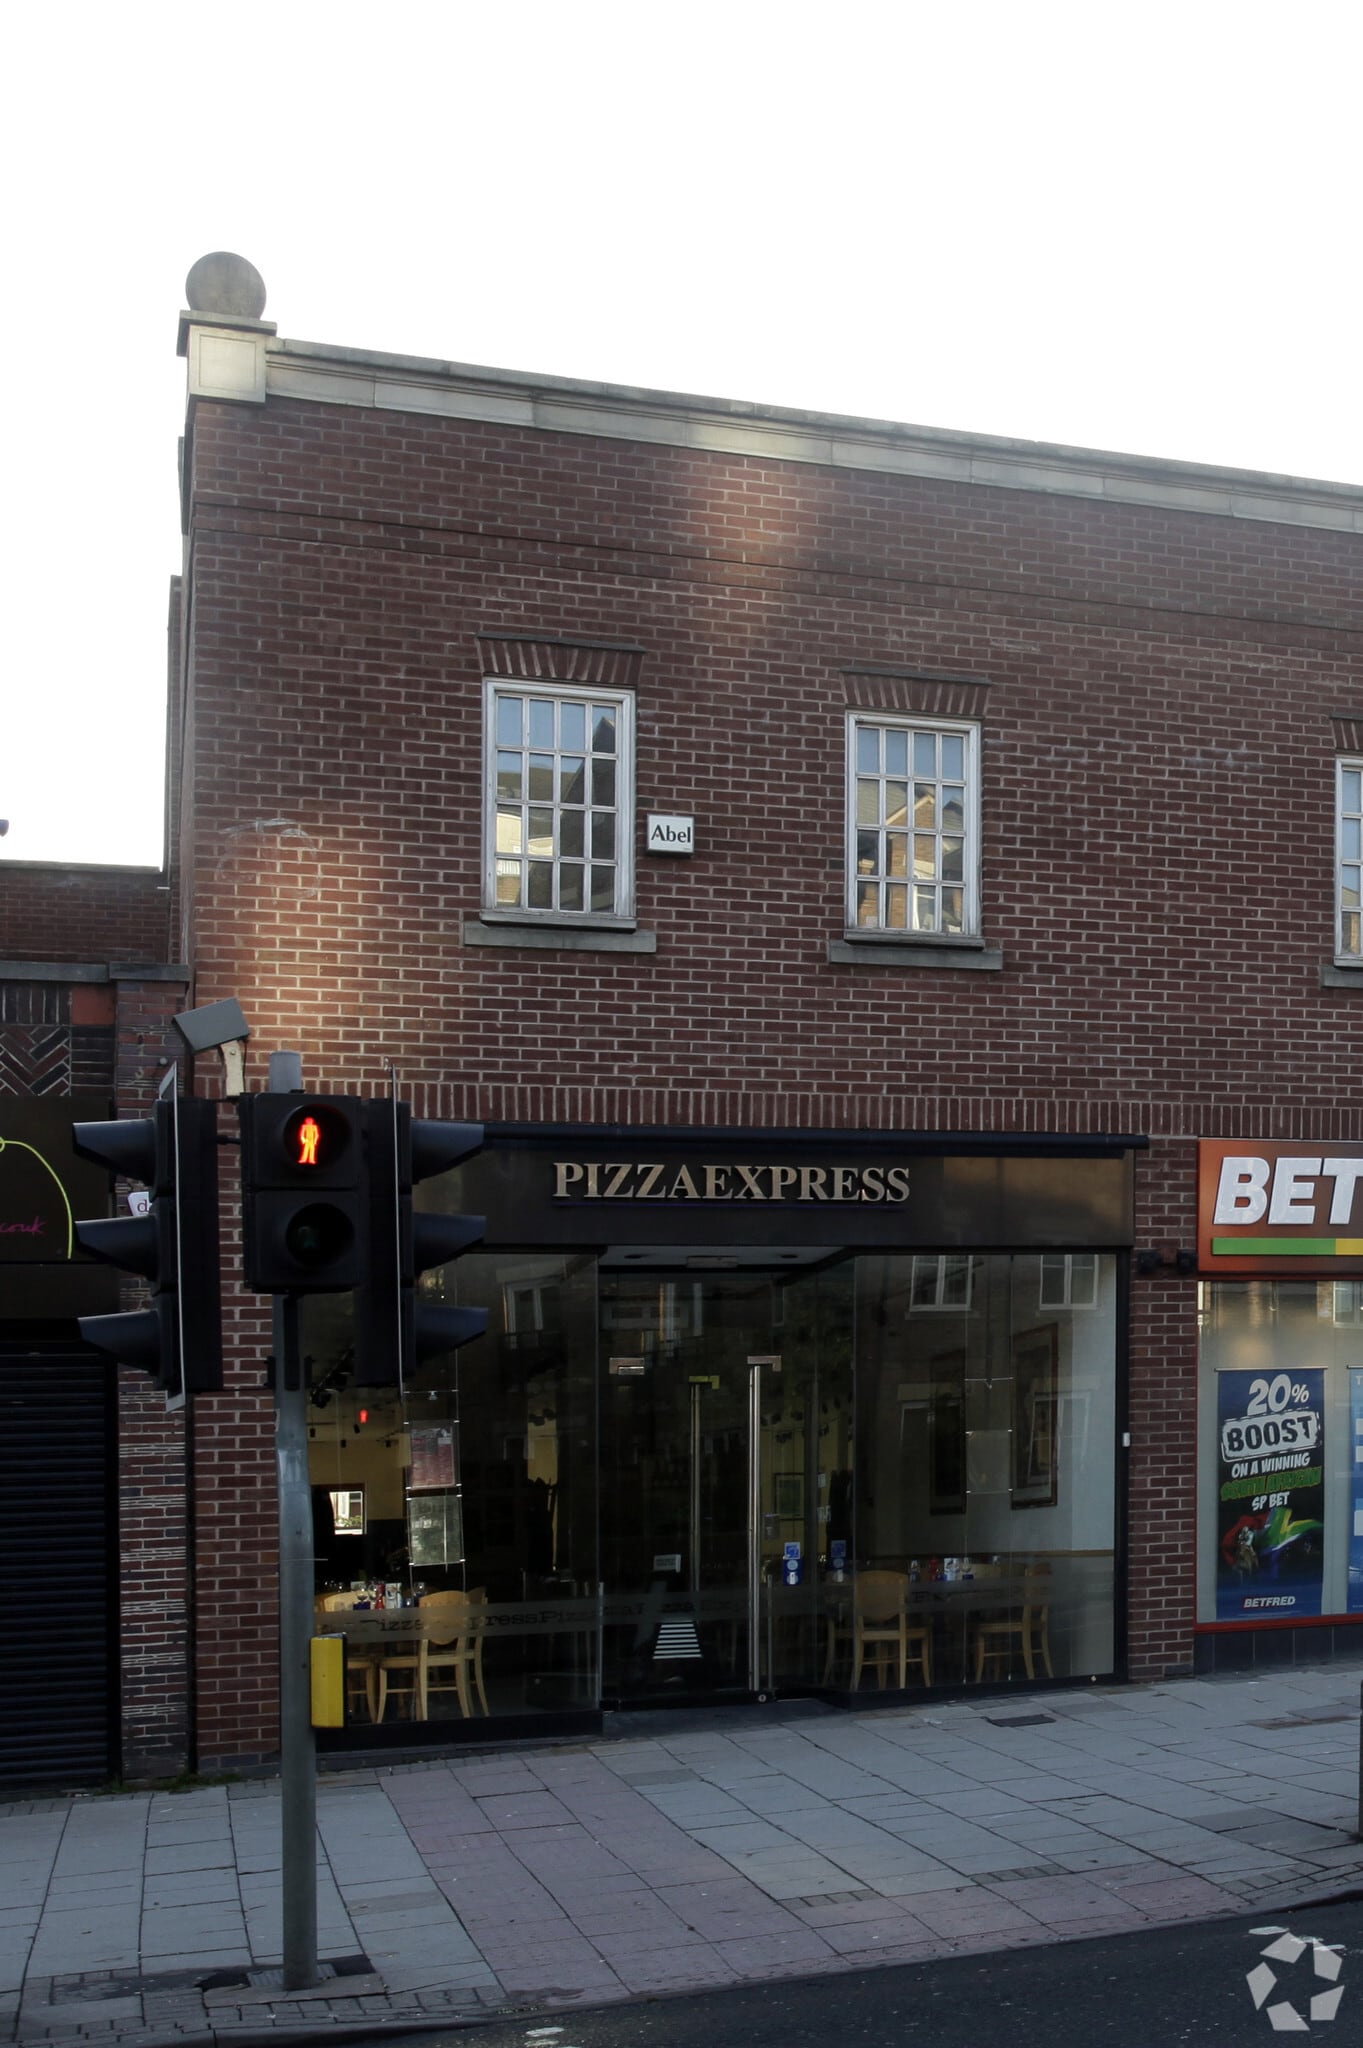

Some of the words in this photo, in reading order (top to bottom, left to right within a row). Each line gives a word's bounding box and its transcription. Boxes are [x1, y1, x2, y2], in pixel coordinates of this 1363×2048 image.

[651, 824, 691, 843] Abel
[553, 1162, 910, 1202] PIZZAEXPRESS
[1213, 1157, 1363, 1225] BET
[1247, 1374, 1310, 1415] 20%
[1227, 1416, 1312, 1452] BOOST
[1231, 1462, 1248, 1479] ON
[1250, 1460, 1259, 1475] A
[1261, 1452, 1311, 1474] WINNING
[1251, 1495, 1268, 1512] SP
[1269, 1491, 1290, 1508] BET
[1243, 1595, 1296, 1609] BETFRED
